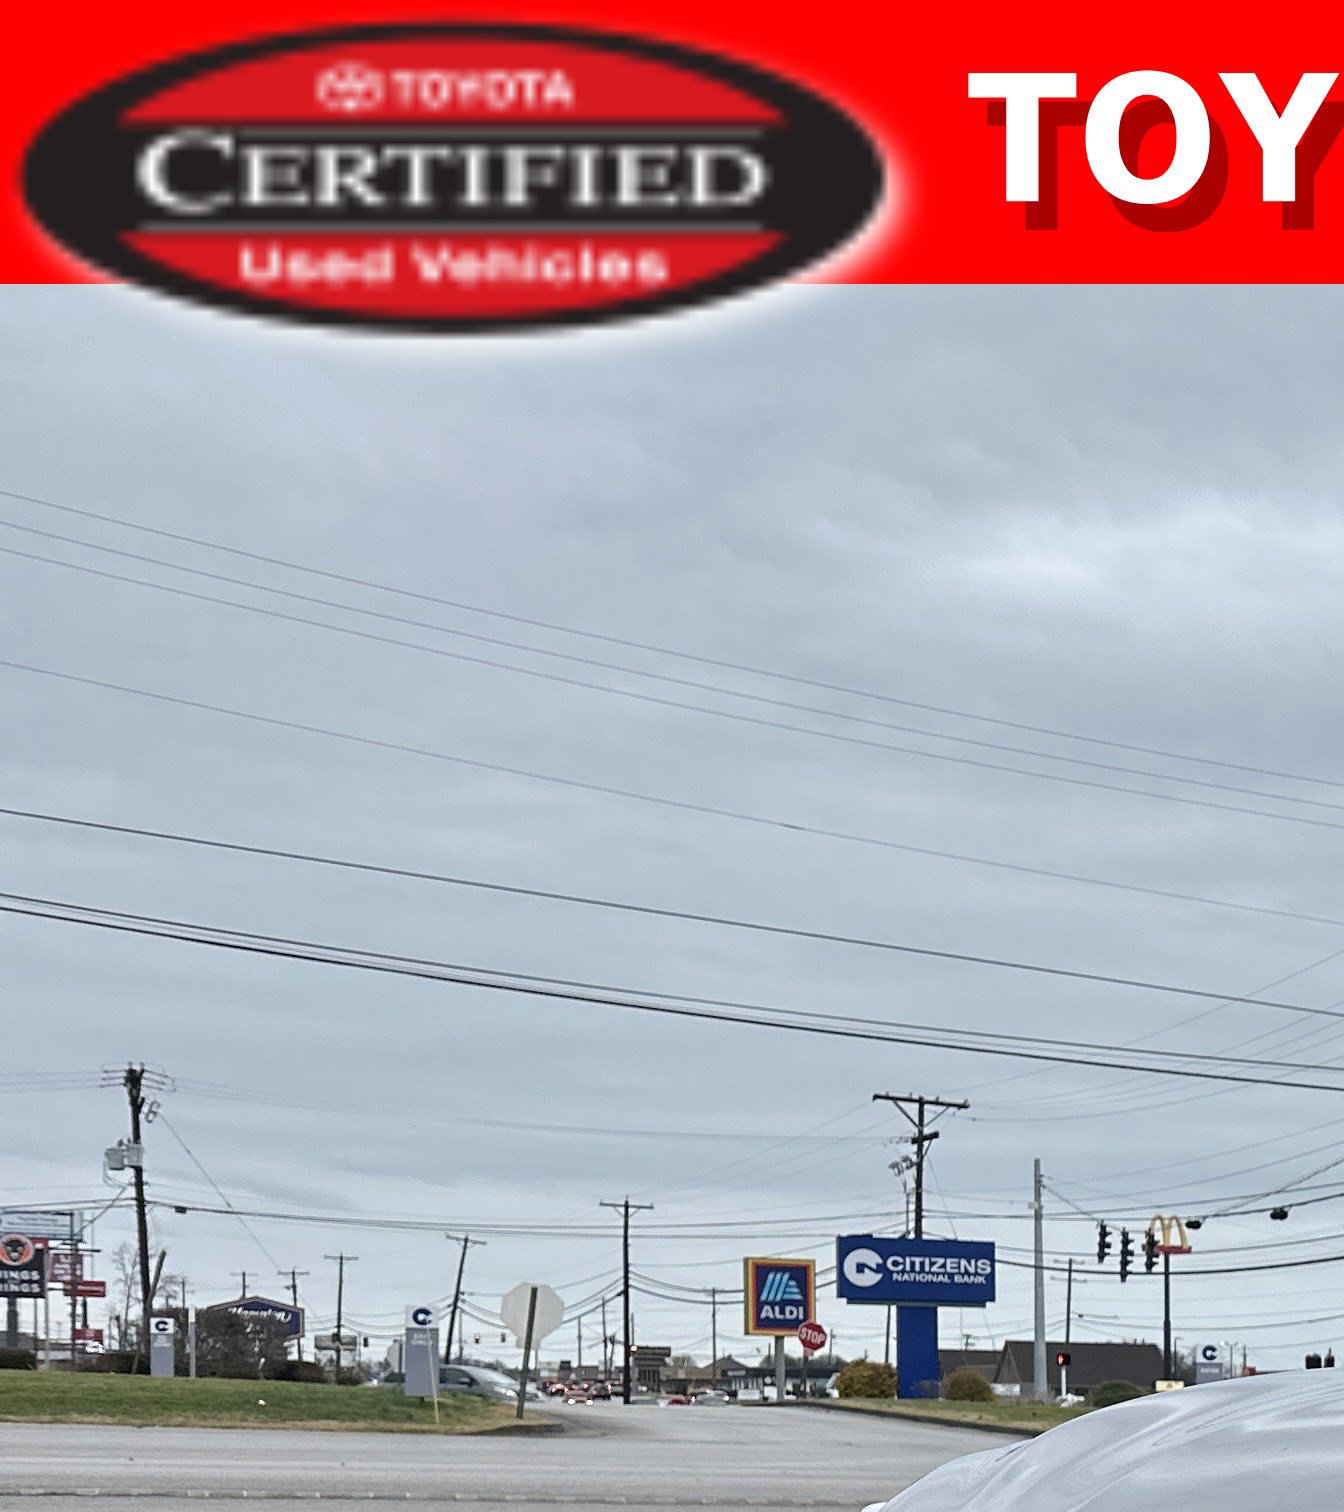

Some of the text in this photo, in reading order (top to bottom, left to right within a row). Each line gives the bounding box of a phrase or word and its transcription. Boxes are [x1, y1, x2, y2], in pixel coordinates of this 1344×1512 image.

[886, 1255, 992, 1275] CITIZENS
[0, 1269, 41, 1281] INGS
[892, 1272, 987, 1285] NATIONAL BANK
[0, 1283, 41, 1293] INGS
[760, 1304, 804, 1320] ALDI
[800, 1326, 826, 1345] STOP
